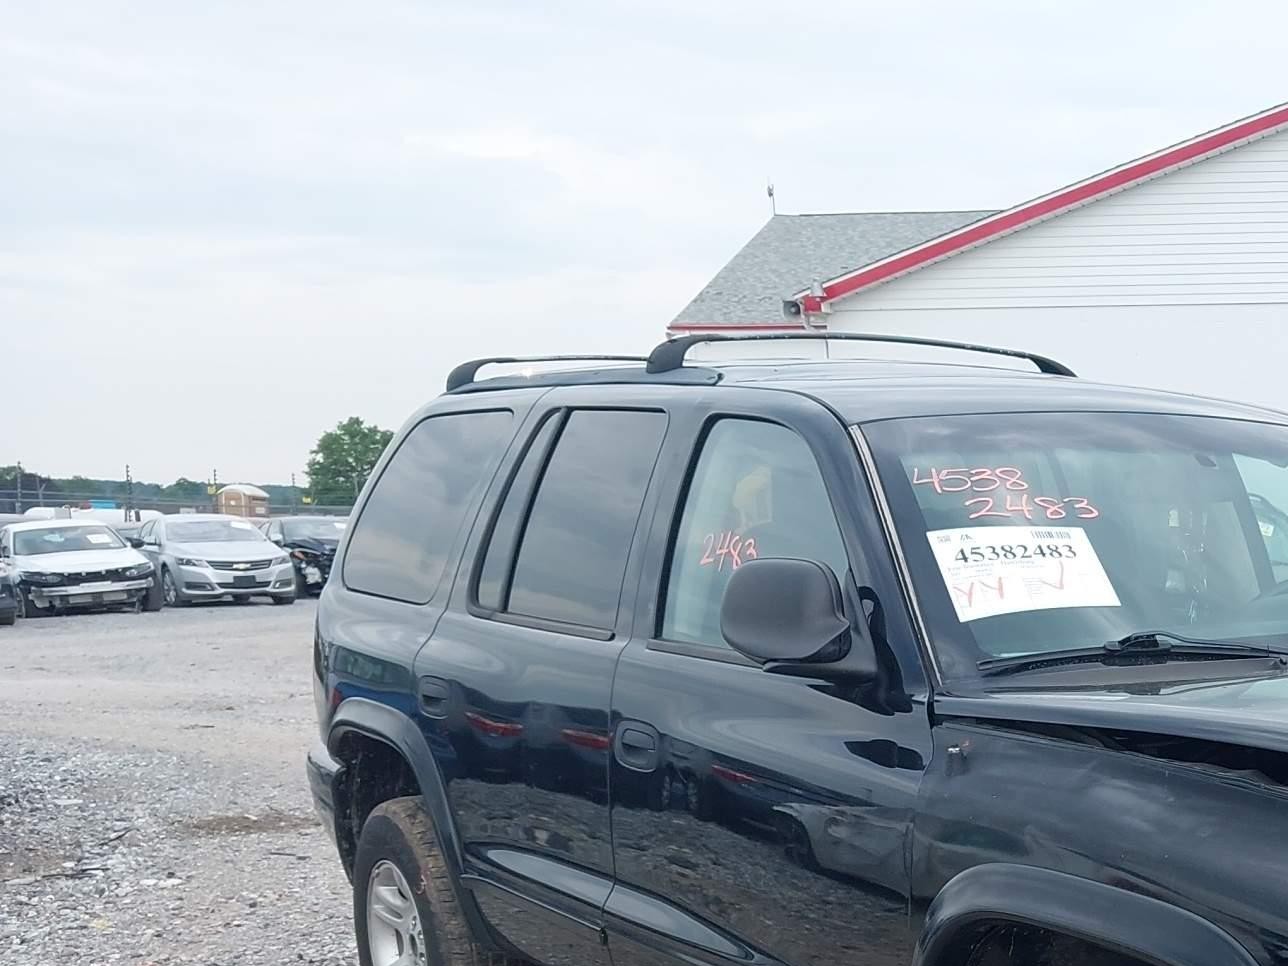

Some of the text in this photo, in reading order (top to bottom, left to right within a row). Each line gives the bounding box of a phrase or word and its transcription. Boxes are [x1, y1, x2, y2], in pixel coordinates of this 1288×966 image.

[912, 466, 1030, 494] 4538
[963, 493, 1100, 521] 2483
[954, 543, 1077, 563] 45382483
